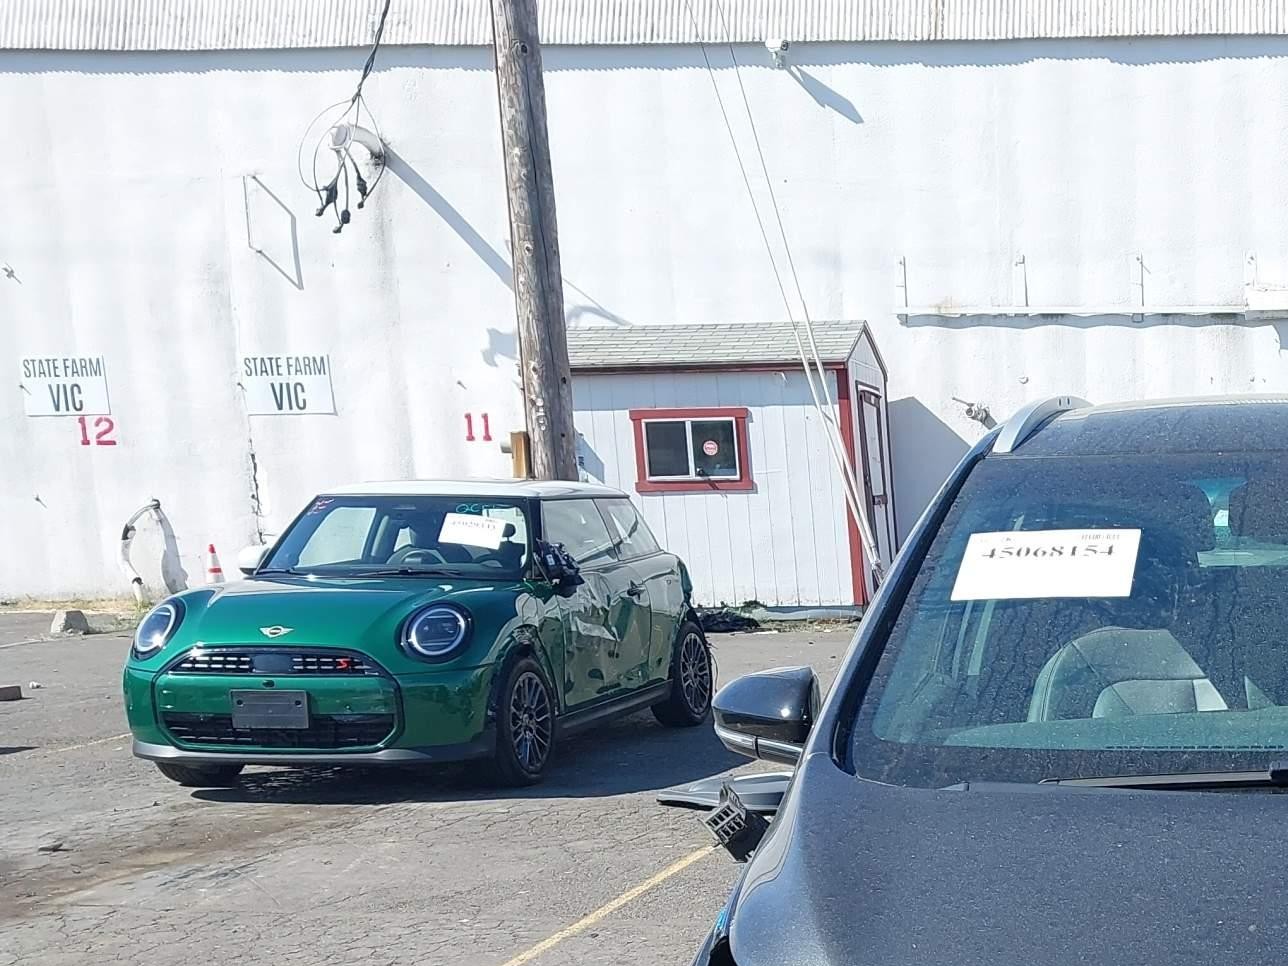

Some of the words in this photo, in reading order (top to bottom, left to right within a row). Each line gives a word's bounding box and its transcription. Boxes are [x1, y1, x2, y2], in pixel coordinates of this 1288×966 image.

[22, 359, 60, 378] STATE
[64, 357, 102, 377] FARM
[245, 357, 283, 376] STATE
[286, 355, 327, 376] FARM
[48, 383, 84, 412] VIC
[270, 382, 307, 411] VIC
[77, 416, 117, 446] 12
[464, 413, 493, 442] 11
[982, 544, 1114, 559] 45068154
